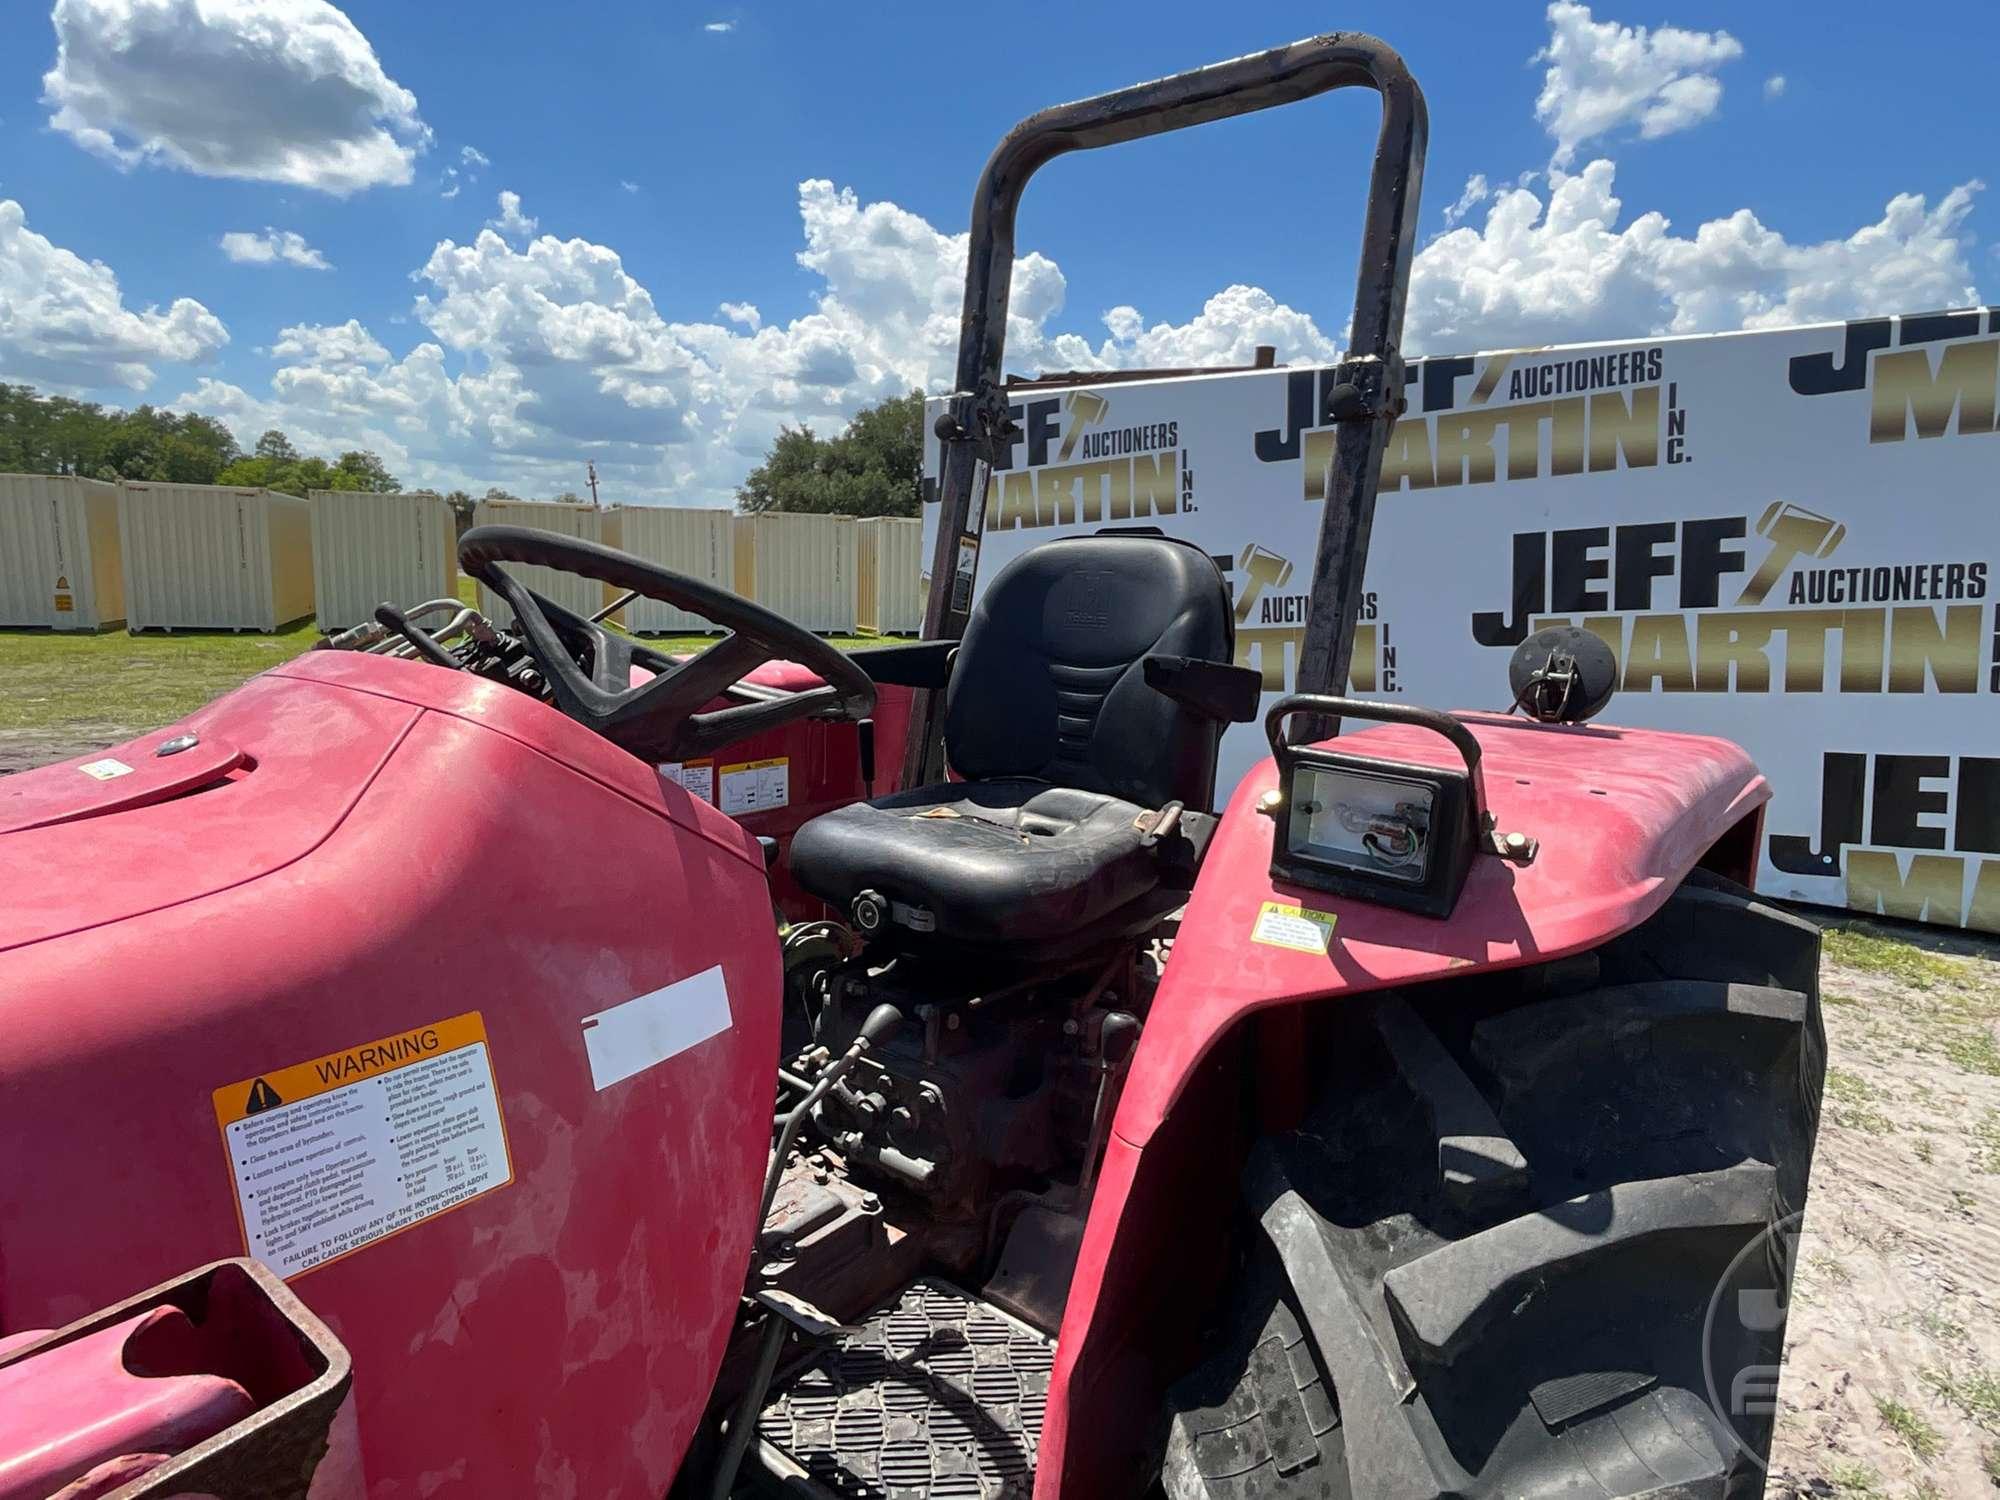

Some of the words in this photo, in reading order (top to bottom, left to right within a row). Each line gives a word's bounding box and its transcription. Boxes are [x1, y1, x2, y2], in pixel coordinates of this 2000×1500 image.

[1508, 348, 1663, 400] AUCTIONEERS
[1082, 422, 1178, 459] AUCTIONEERS
[986, 451, 1177, 532] ARTIN
[1472, 516, 1747, 647] JEFF
[1788, 562, 1988, 605] AUCTIONEERS
[315, 1030, 439, 1084] WARNING
[392, 1073, 401, 1081] not
[402, 1067, 419, 1079] permit
[392, 1082, 403, 1090] ride
[431, 1068, 446, 1076] There
[242, 1119, 264, 1130] Before
[289, 1105, 302, 1115] and
[302, 1097, 332, 1110] operating
[388, 1092, 401, 1102] place
[389, 1096, 412, 1111] provided
[391, 1112, 404, 1120] Slow
[405, 1107, 419, 1116] down
[443, 1092, 457, 1102] rough
[458, 1085, 476, 1098] ground
[476, 1082, 485, 1090] and
[244, 1124, 276, 1139] operating
[276, 1118, 289, 1128] and
[246, 1140, 257, 1148] the
[290, 1119, 313, 1133] Manual
[314, 1115, 325, 1125] and
[393, 1120, 410, 1129] slopes
[417, 1110, 431, 1121] avoid
[452, 1120, 468, 1130] engine
[469, 1115, 479, 1123] and
[249, 1154, 266, 1164] Clear
[267, 1150, 278, 1158] the
[279, 1144, 294, 1153] area
[294, 1139, 301, 1148] of
[396, 1132, 412, 1142] Lower
[399, 1149, 414, 1160] apply
[415, 1141, 435, 1155] parking
[435, 1136, 450, 1145] brake
[450, 1130, 466, 1139] before
[252, 1168, 273, 1180] Locate
[274, 1161, 287, 1172] and
[287, 1157, 304, 1167] know
[305, 1146, 334, 1161] operation
[334, 1141, 341, 1150] of
[255, 1186, 272, 1197] Start
[273, 1179, 295, 1191] engine
[295, 1172, 309, 1183] only
[309, 1167, 325, 1177] from
[356, 1150, 367, 1160] seat
[258, 1195, 271, 1207] and
[303, 1178, 321, 1189] clutch
[267, 1205, 278, 1213] the
[304, 1188, 318, 1199] PTO
[352, 1170, 364, 1180] and
[292, 1199, 313, 1214] control
[321, 1191, 338, 1201] lower
[263, 1226, 279, 1238] Lock
[279, 1219, 301, 1231] brakes
[283, 1244, 318, 1265] FAILURE
[320, 1239, 332, 1248] TO
[333, 1224, 366, 1244] FOLLOW
[368, 1216, 384, 1229] ANY
[386, 1211, 396, 1221] OF
[398, 1204, 413, 1216] THE
[414, 1182, 465, 1209] INSTRUCTIONS
[466, 1171, 488, 1187] ABOVE
[284, 1228, 297, 1239] and
[338, 1207, 353, 1217] while
[354, 1199, 374, 1211] driving
[301, 1255, 319, 1268] CAN
[321, 1242, 348, 1260] CAUSE
[350, 1227, 384, 1247] SERIOUS
[385, 1215, 413, 1232] INJURY
[414, 1210, 424, 1219] TO
[426, 1203, 439, 1214] THE
[441, 1186, 477, 1207] OPERATOR
